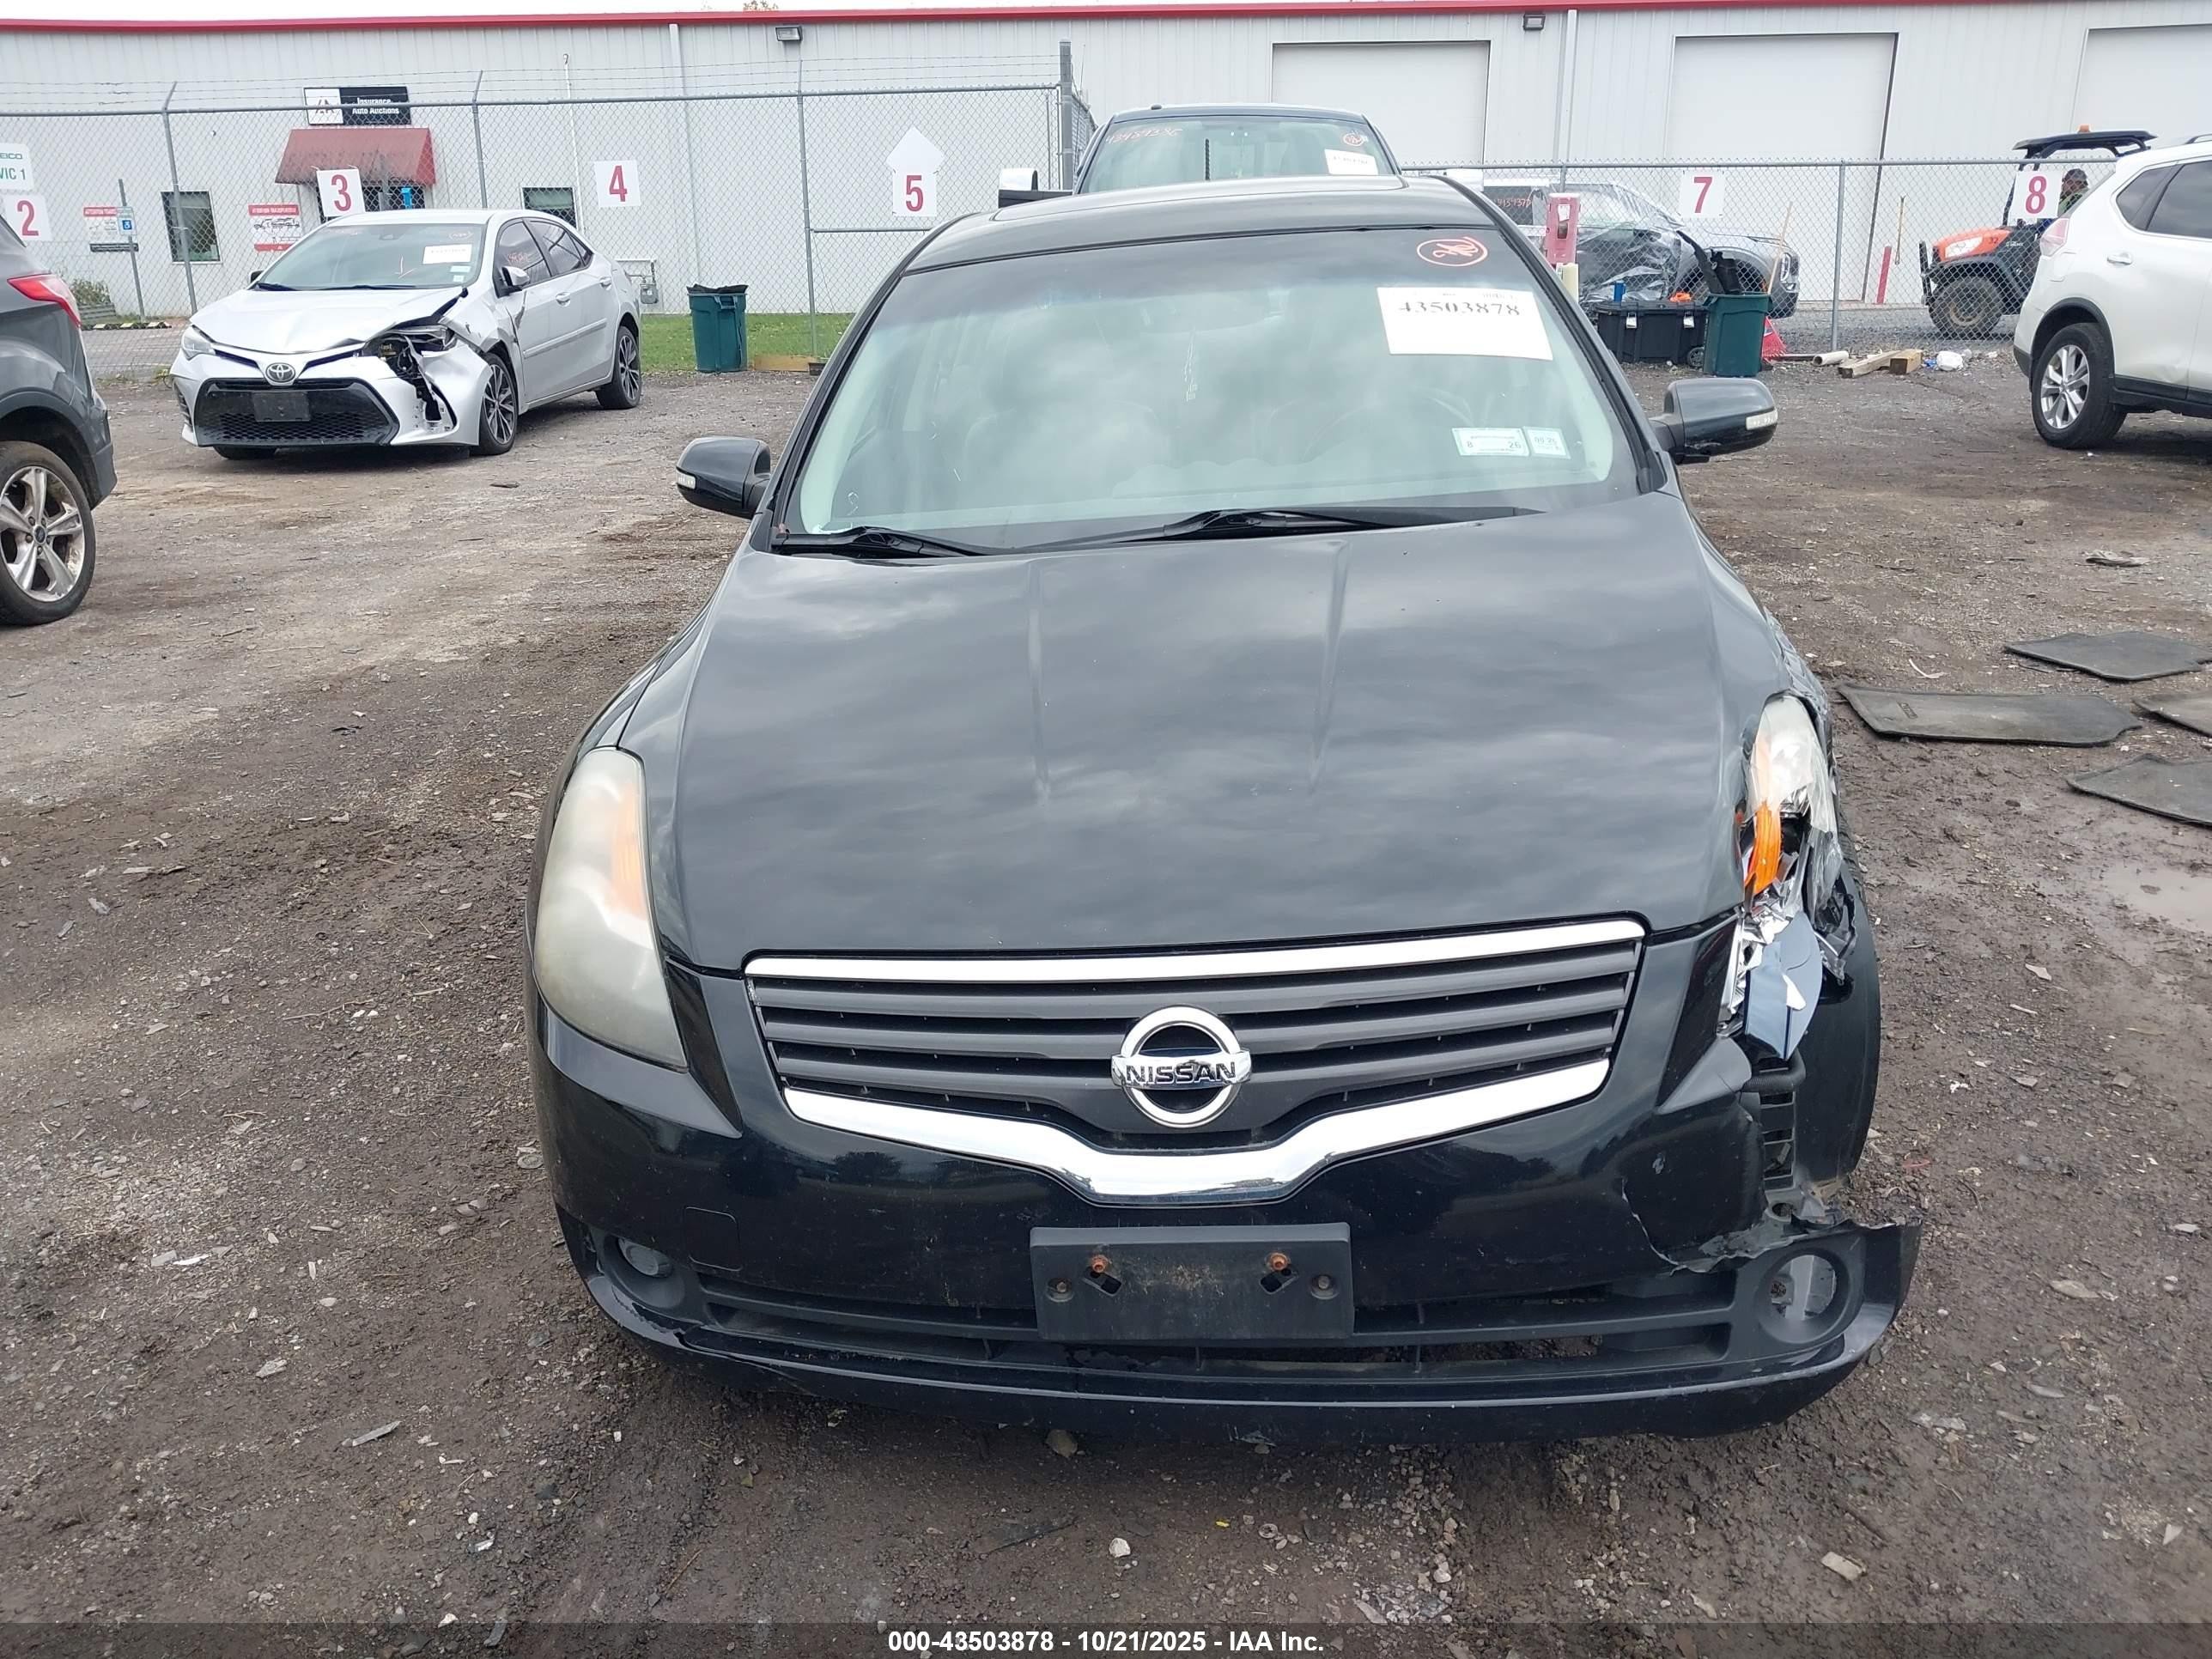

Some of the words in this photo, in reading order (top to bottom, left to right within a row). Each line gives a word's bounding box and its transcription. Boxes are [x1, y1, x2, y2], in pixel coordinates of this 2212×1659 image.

[21, 167, 26, 180] 1
[609, 165, 628, 202] 4
[331, 174, 351, 211] 3
[905, 174, 924, 212] 5
[1694, 177, 1712, 213] 7
[2025, 175, 2047, 214] 8
[16, 200, 40, 236] 2
[1399, 301, 1520, 316] 43503878
[1126, 1061, 1236, 1085] NISSAN
